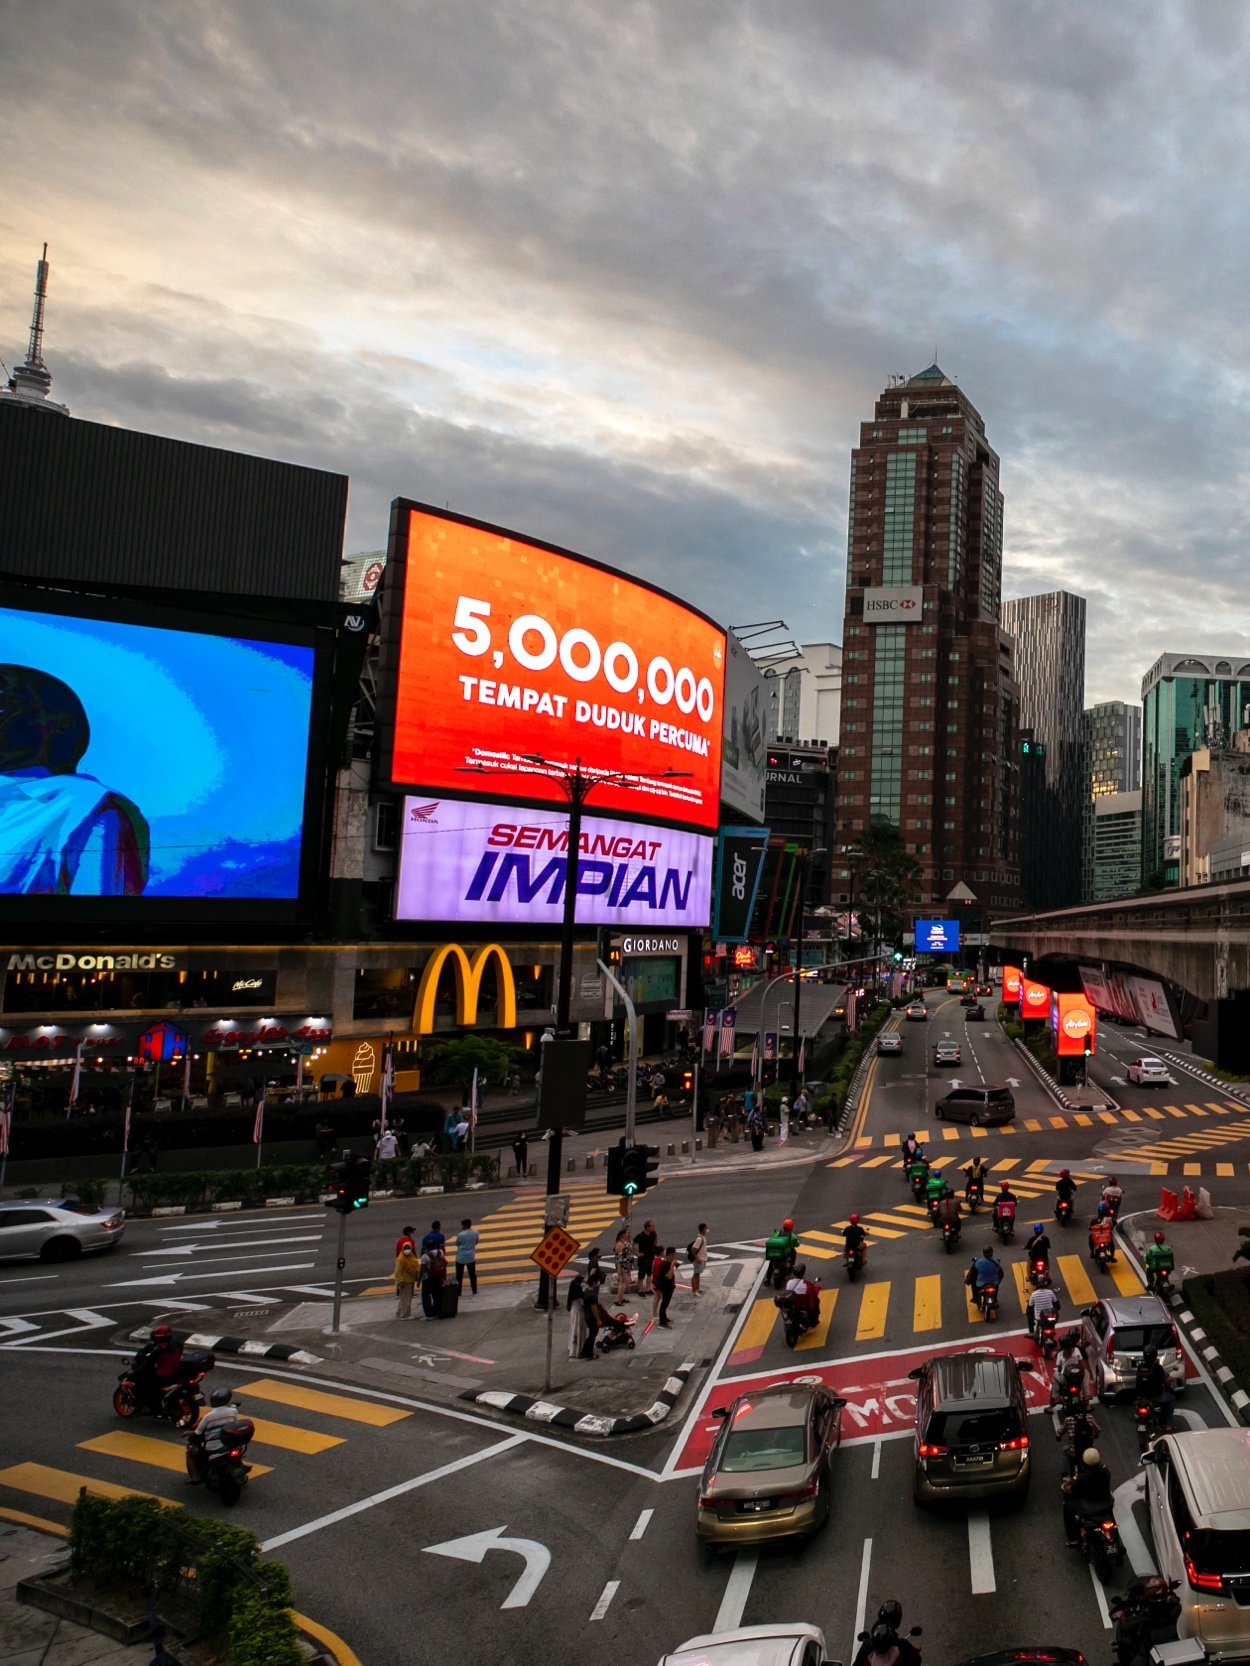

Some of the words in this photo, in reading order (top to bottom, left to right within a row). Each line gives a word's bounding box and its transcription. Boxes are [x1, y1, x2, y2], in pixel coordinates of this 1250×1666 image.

[867, 600, 898, 611] HSBC
[452, 595, 714, 722] 5,000,000
[458, 675, 568, 718] TEMPAT
[575, 700, 646, 738] DUDUK
[766, 772, 803, 784] URNAL
[487, 823, 662, 861] SEMANGAT
[465, 851, 692, 910] IMPIAN
[731, 851, 747, 900] acer
[7, 953, 176, 971] McDonald's
[623, 938, 679, 953] GIORDANO
